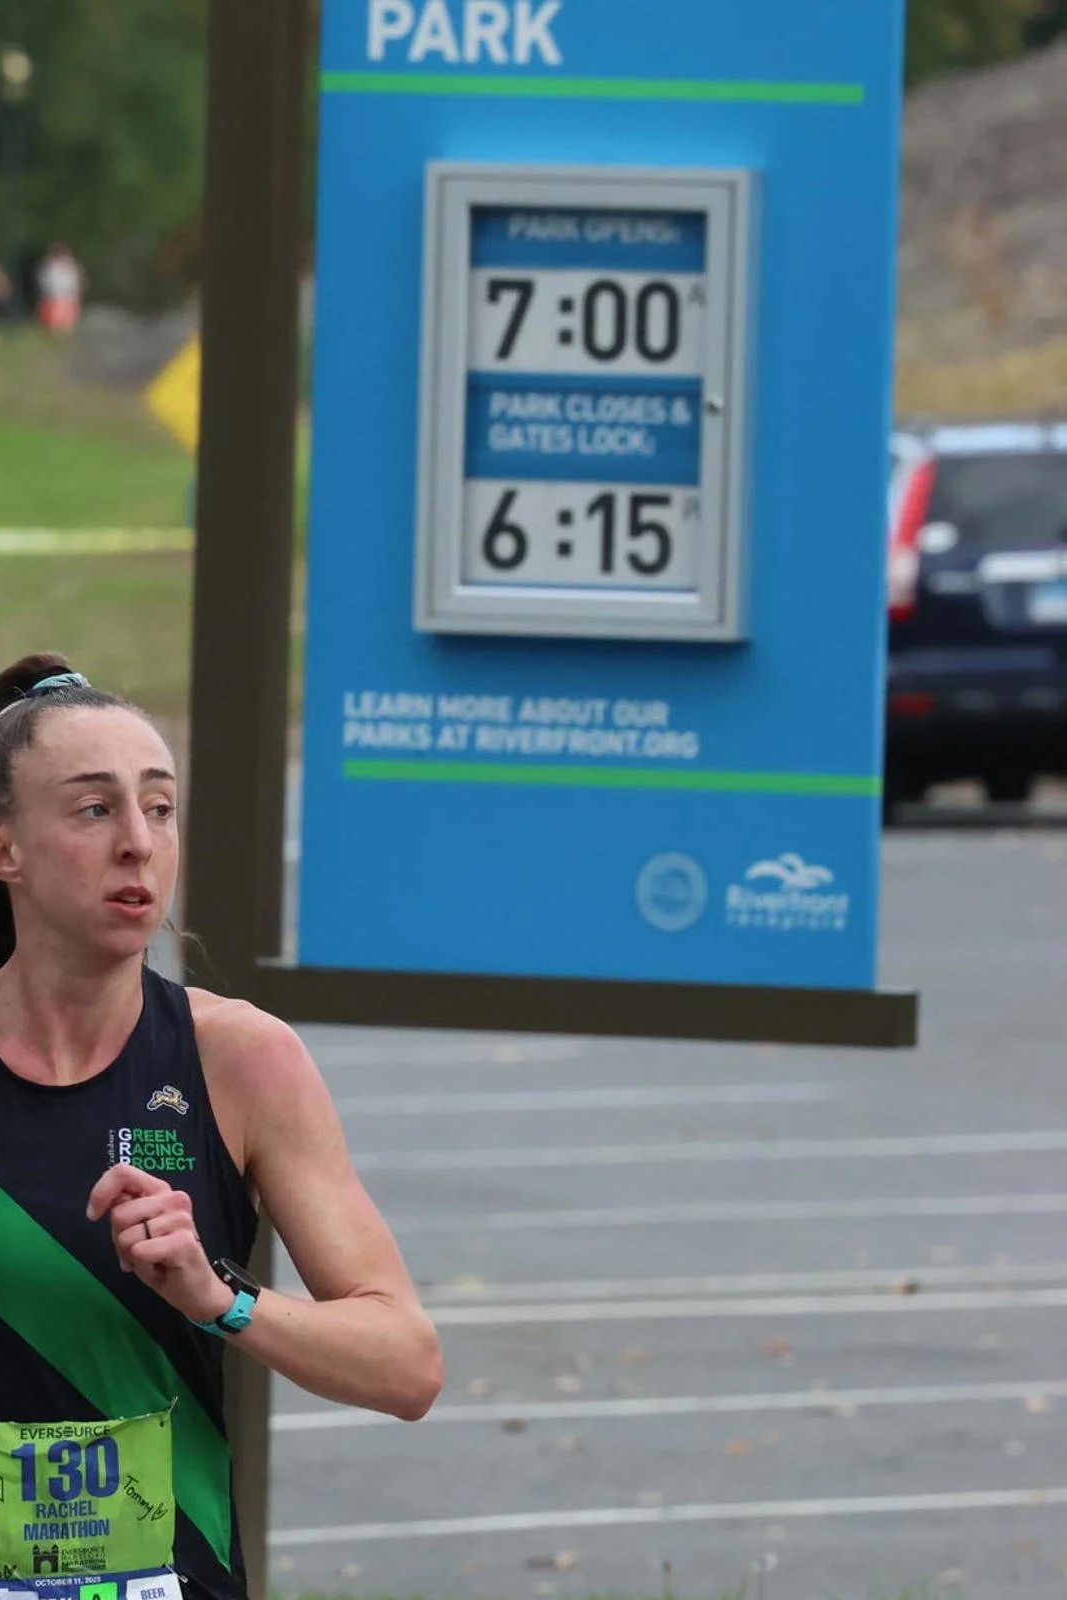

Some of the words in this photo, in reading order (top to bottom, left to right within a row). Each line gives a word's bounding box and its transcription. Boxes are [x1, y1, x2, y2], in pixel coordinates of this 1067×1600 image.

[366, 0, 564, 66] PARK
[508, 214, 579, 243] PARK
[486, 278, 680, 363] 7:00
[489, 391, 561, 421] PARK
[565, 393, 666, 425] CLOSES
[670, 397, 691, 426] &
[487, 422, 573, 454] GATES
[482, 489, 674, 577] 6:15
[343, 692, 433, 720] LEARN
[437, 694, 513, 723] MORE
[518, 697, 607, 726] ABOUT
[611, 699, 670, 728] OUR
[343, 720, 432, 749] PARKS
[436, 723, 470, 750] AT
[475, 725, 699, 759] RIVERFRONT.ORG
[118, 1127, 177, 1142] GREEN
[118, 1141, 185, 1156] RACING
[119, 1156, 197, 1171] PROJECT
[20, 1424, 112, 1440] EVERSOURCE
[9, 1437, 121, 1502] 130
[35, 1500, 98, 1519] RACHEL
[23, 1519, 111, 1541] MARATHON
[35, 1578, 73, 1587] OCTOBER
[140, 1587, 166, 1600] BEER
